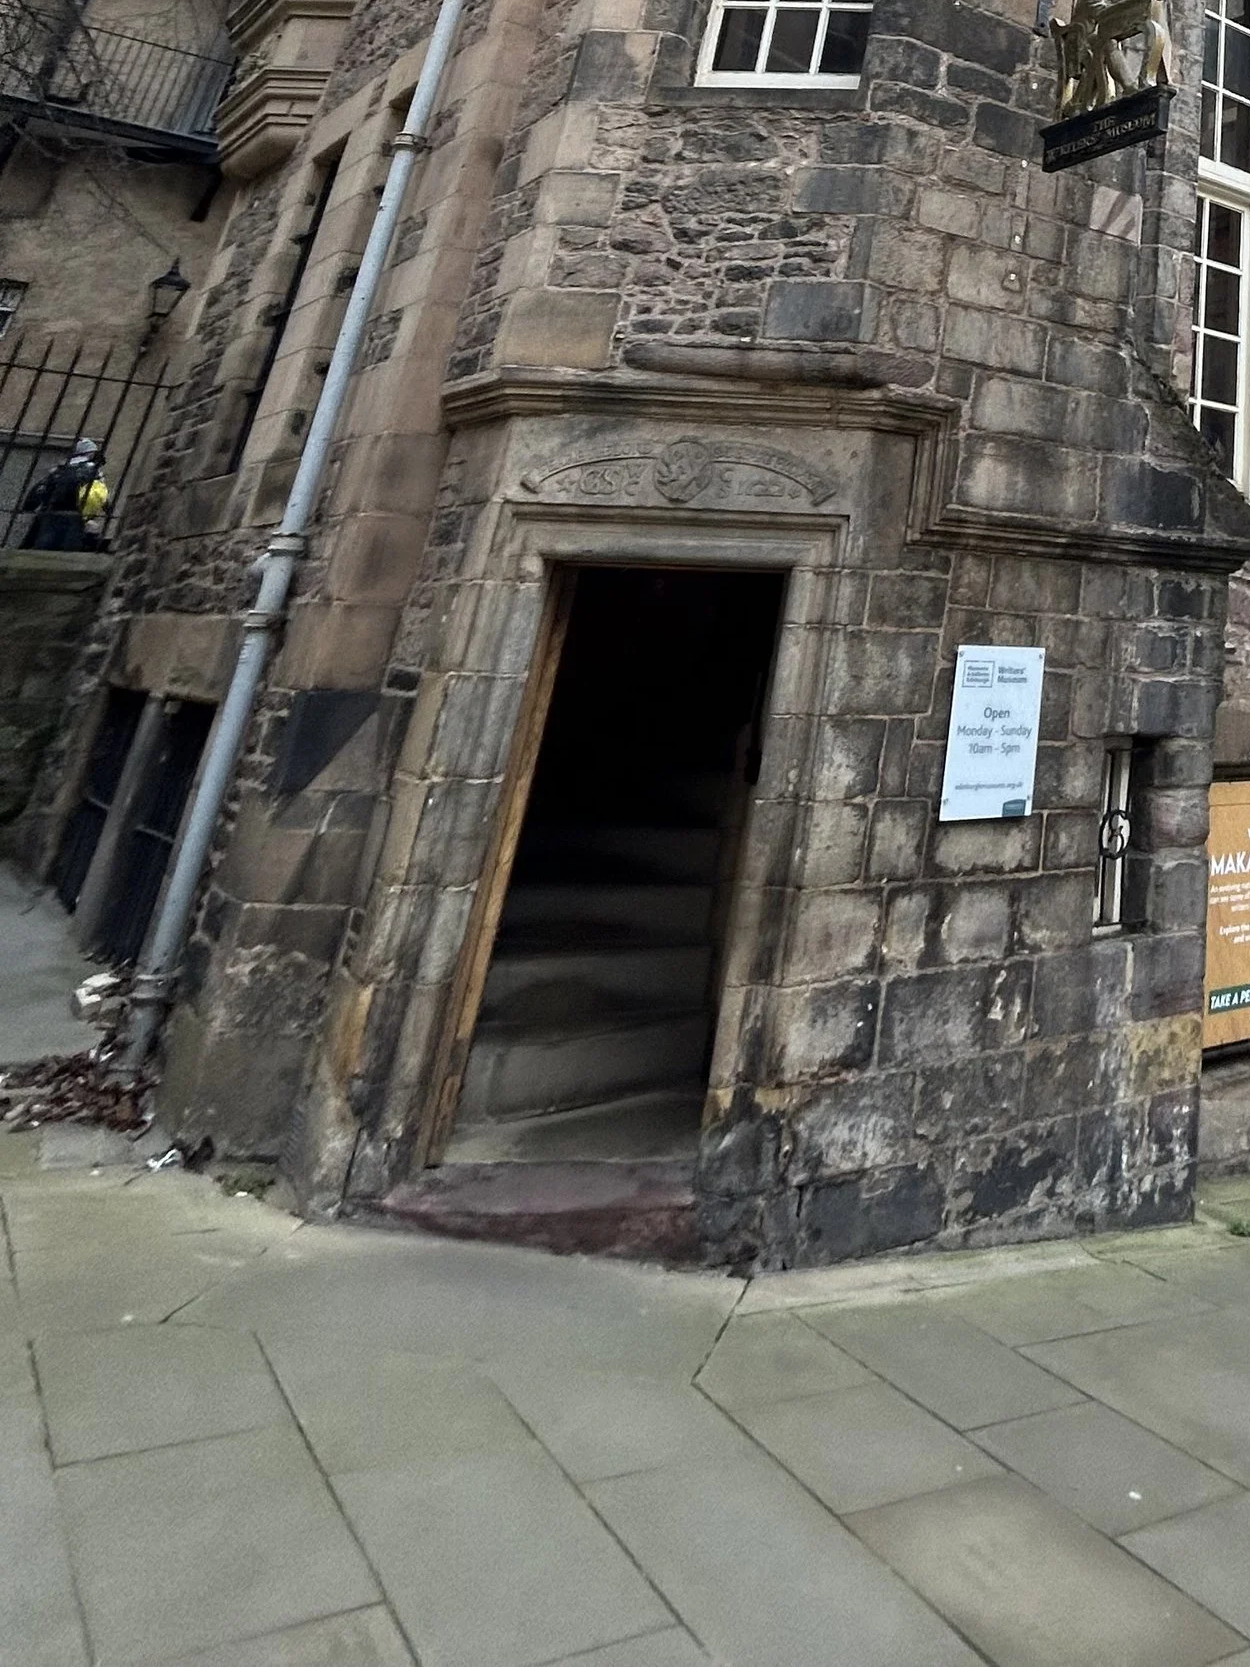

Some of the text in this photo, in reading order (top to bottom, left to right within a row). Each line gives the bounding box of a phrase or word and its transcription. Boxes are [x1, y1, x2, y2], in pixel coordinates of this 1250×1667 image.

[1106, 113, 1156, 138] MUSEUM
[997, 675, 1027, 684] Museum
[983, 706, 1010, 722] Open
[957, 725, 993, 739] Monday
[1001, 725, 1032, 739] Sunday
[968, 743, 993, 754] 10am
[1001, 742, 1021, 756] 5pm
[1210, 992, 1231, 1010] TAKE
[1231, 991, 1239, 1005] A
